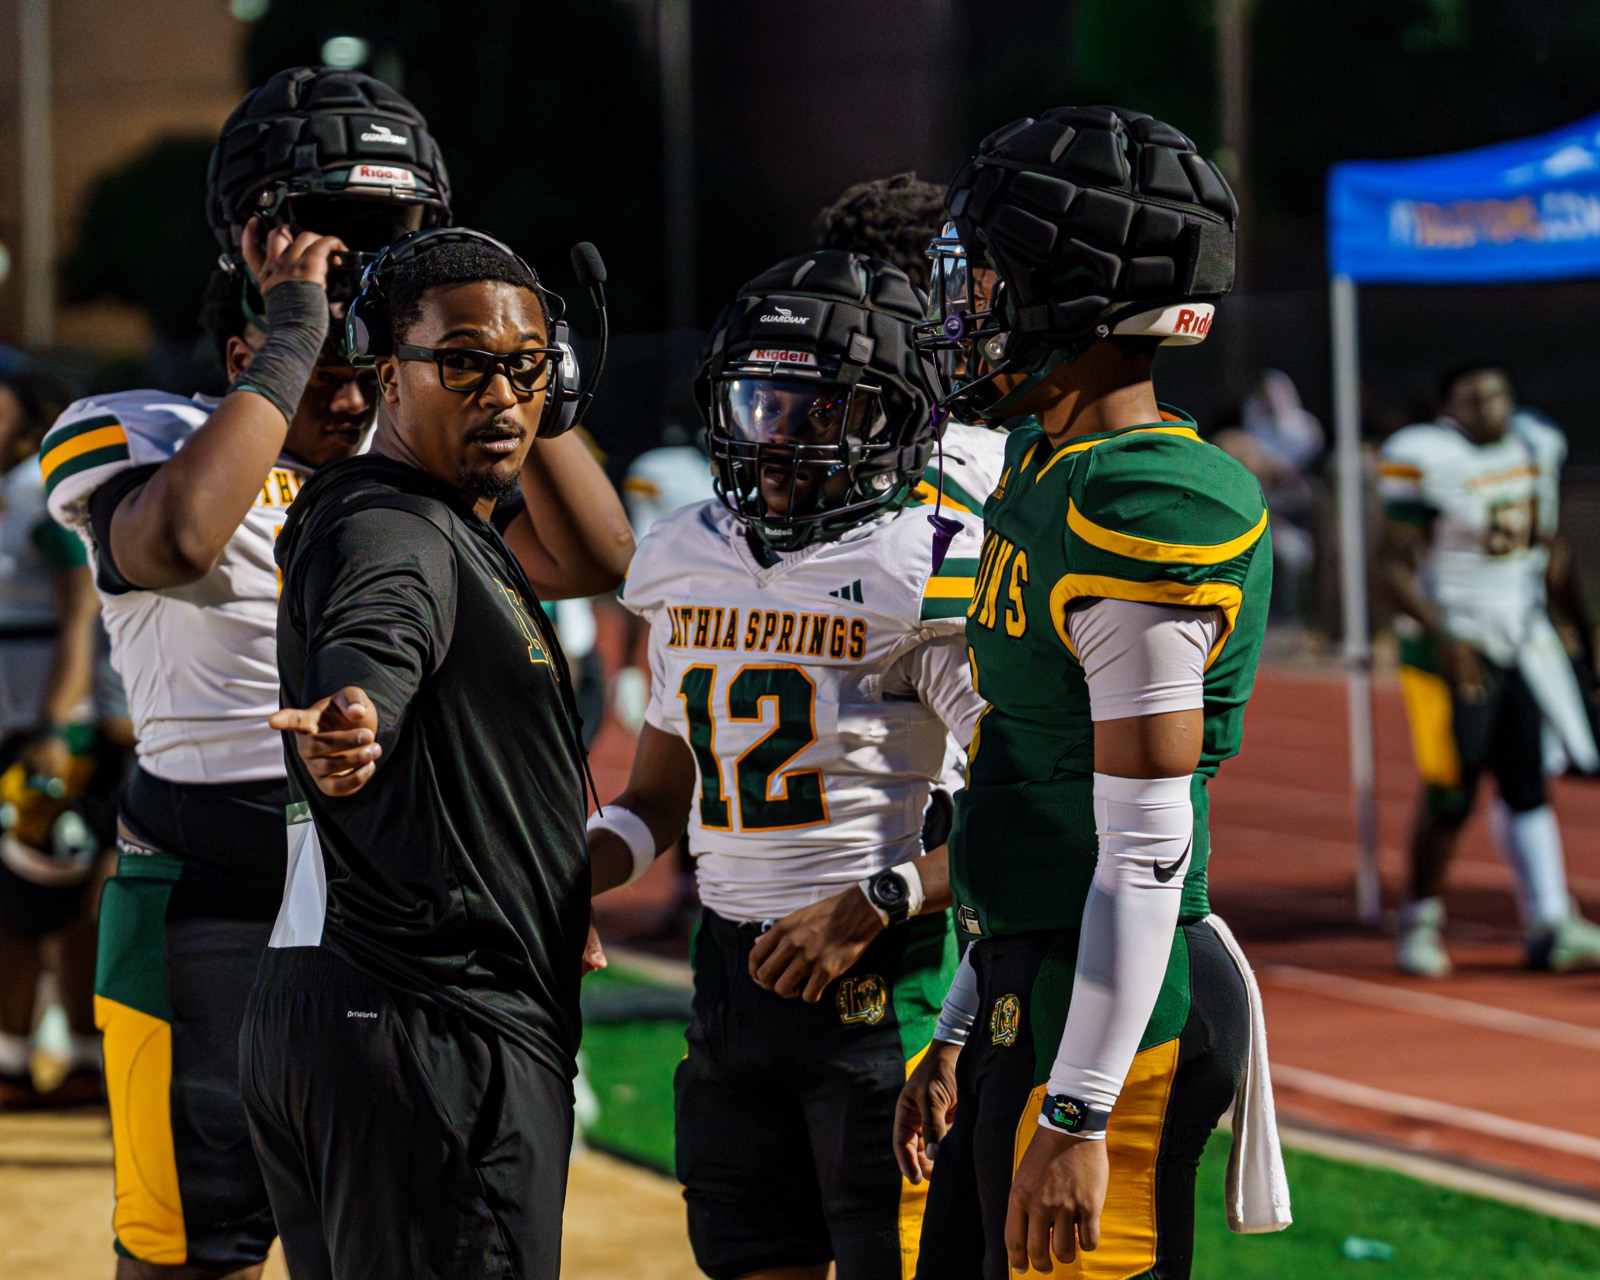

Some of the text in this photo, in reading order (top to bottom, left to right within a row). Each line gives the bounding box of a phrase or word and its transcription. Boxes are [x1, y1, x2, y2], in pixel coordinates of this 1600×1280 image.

[760, 315, 807, 325] GUARDIAN
[755, 349, 809, 363] Riddell
[744, 609, 868, 661] SPRINGS
[676, 663, 830, 833] 12
